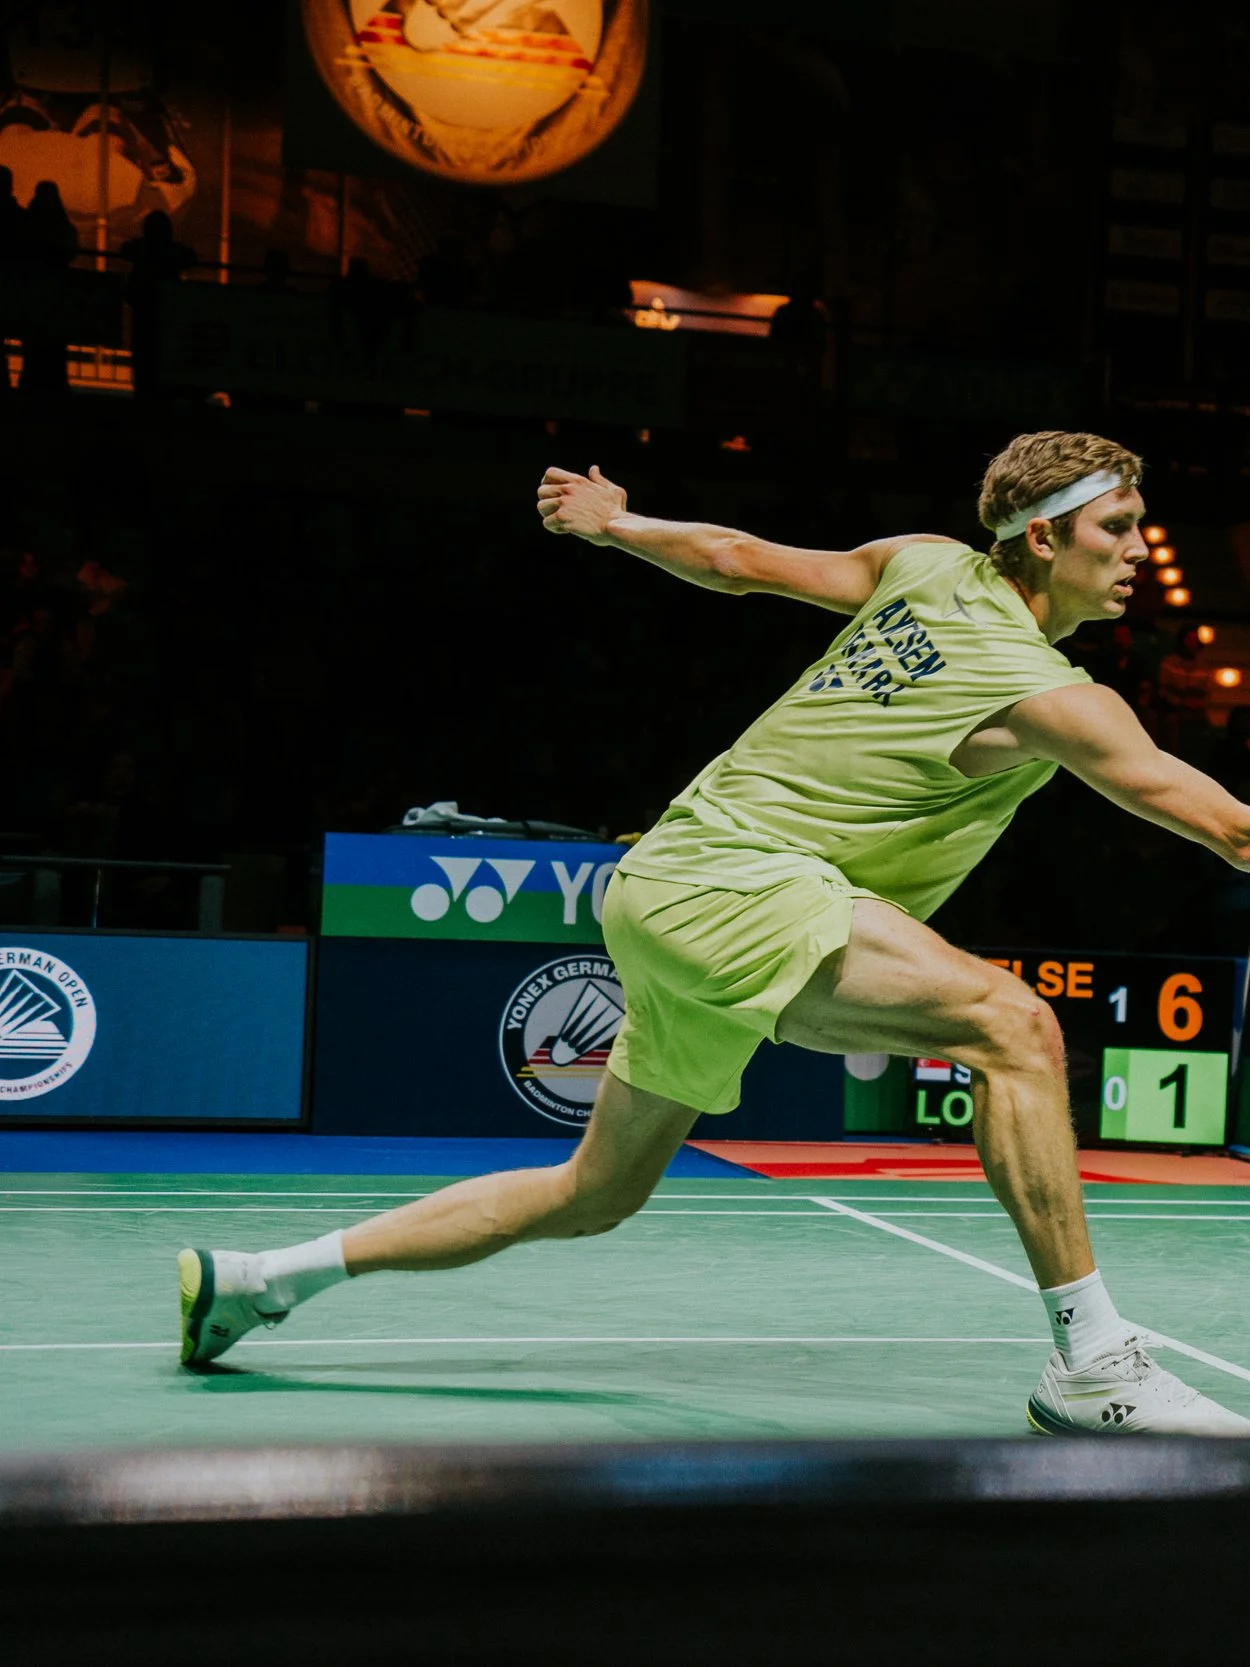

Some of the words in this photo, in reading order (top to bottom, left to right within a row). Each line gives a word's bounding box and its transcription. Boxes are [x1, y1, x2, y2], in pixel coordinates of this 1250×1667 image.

[58, 971, 89, 1008] OPEN
[506, 973, 553, 1031] YONEX
[1108, 986, 1128, 1023] 1
[1157, 972, 1204, 1042] 6
[523, 1079, 575, 1115] BADMINTON
[1103, 1076, 1128, 1111] 0
[1159, 1063, 1189, 1129] 1
